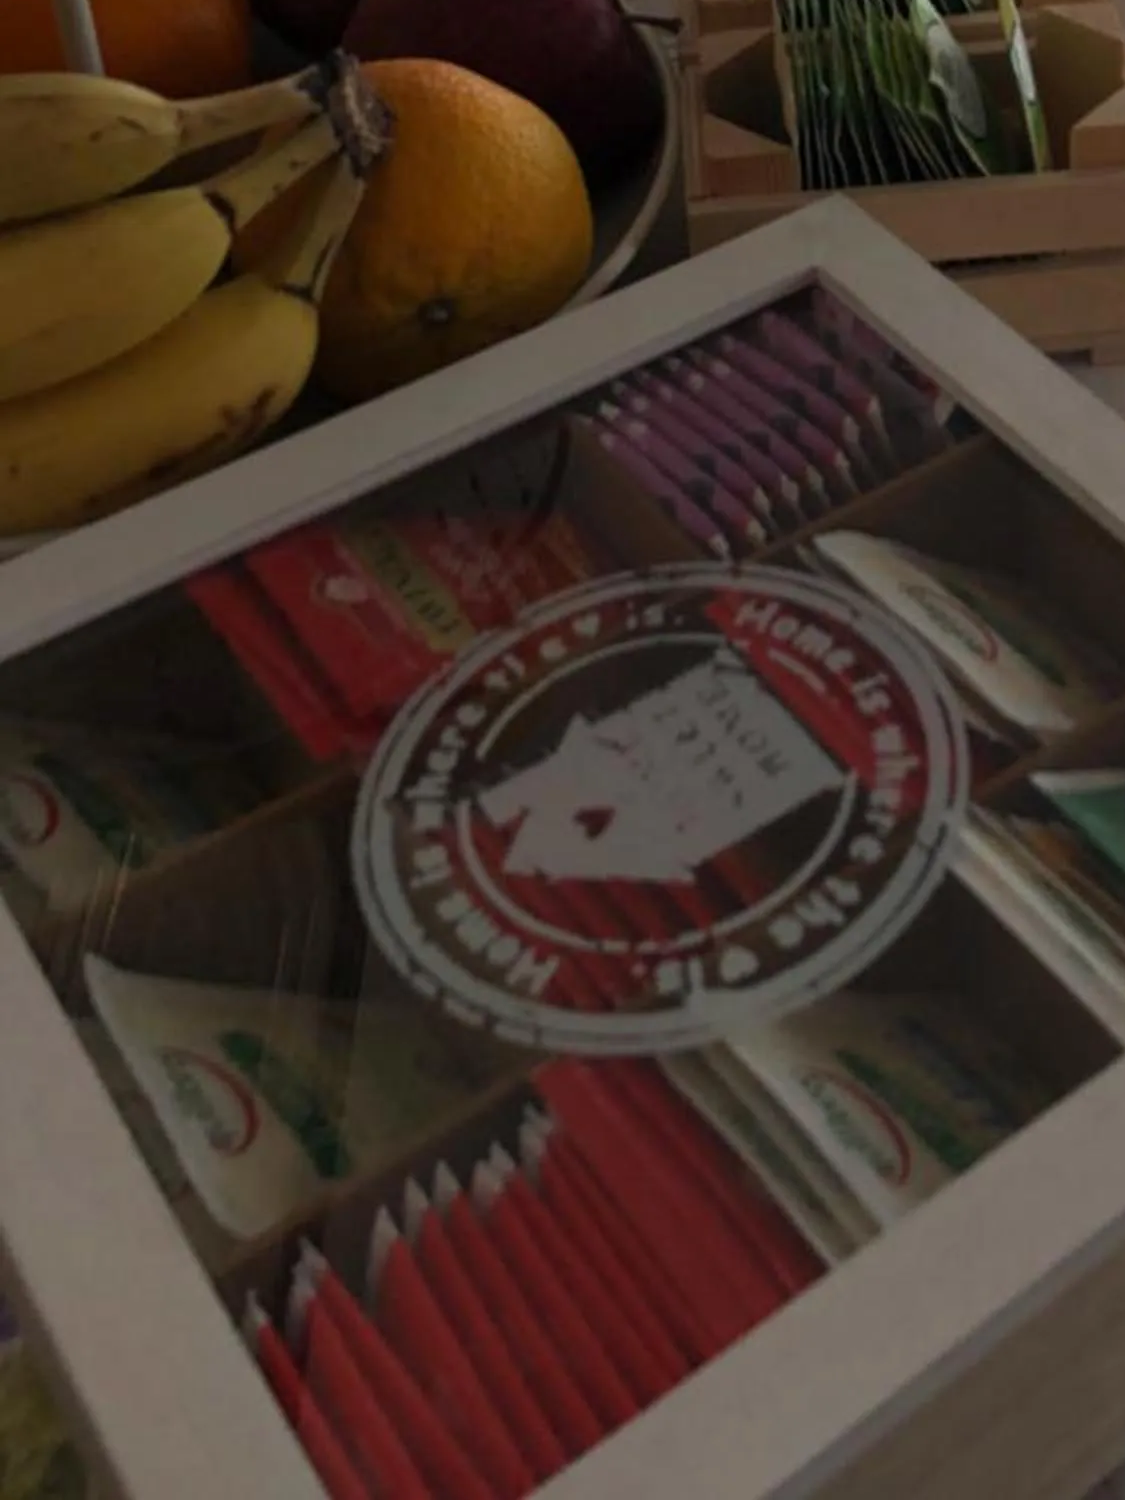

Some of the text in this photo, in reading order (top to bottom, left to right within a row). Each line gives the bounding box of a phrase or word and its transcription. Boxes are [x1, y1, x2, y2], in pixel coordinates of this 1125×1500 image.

[735, 600, 855, 674] Home
[852, 672, 893, 717] is
[849, 722, 921, 864] where
[437, 891, 562, 995] Home
[768, 875, 862, 950] the
